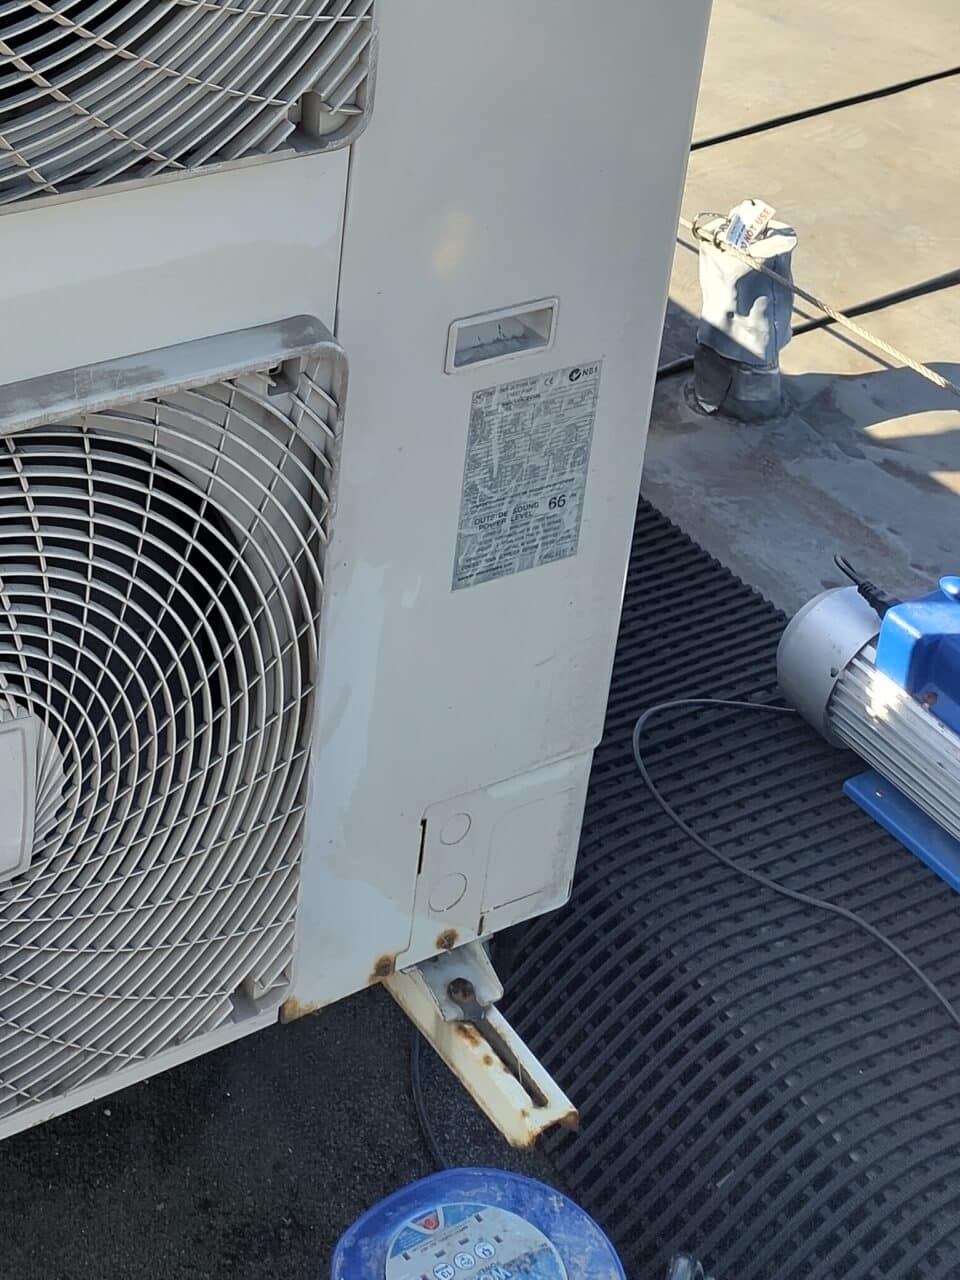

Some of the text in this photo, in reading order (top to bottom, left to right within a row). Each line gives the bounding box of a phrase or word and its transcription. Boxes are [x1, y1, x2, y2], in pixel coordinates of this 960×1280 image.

[743, 225, 756, 244] NOT
[755, 207, 770, 225] USE
[548, 494, 567, 510] 66
